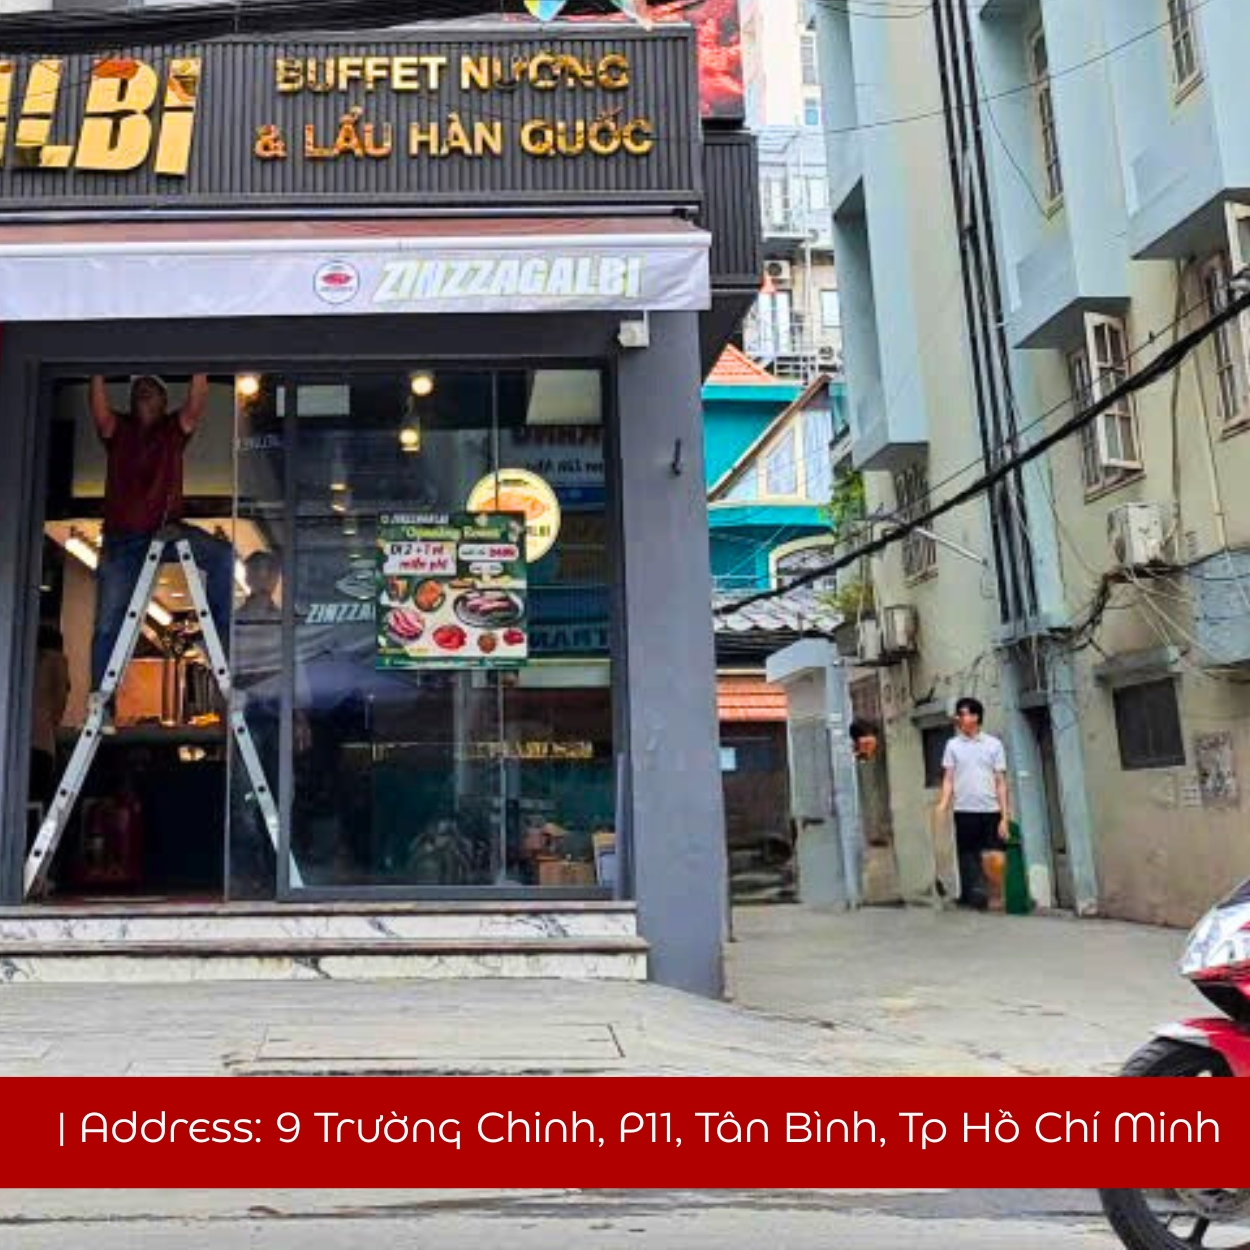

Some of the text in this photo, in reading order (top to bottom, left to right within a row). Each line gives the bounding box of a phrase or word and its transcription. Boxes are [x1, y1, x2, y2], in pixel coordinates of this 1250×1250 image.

[275, 55, 447, 93] BUFFET
[254, 124, 286, 158] &
[408, 111, 502, 157] HÀN
[520, 105, 653, 158] QUỐC
[372, 256, 643, 301] ZINZZAGALBI
